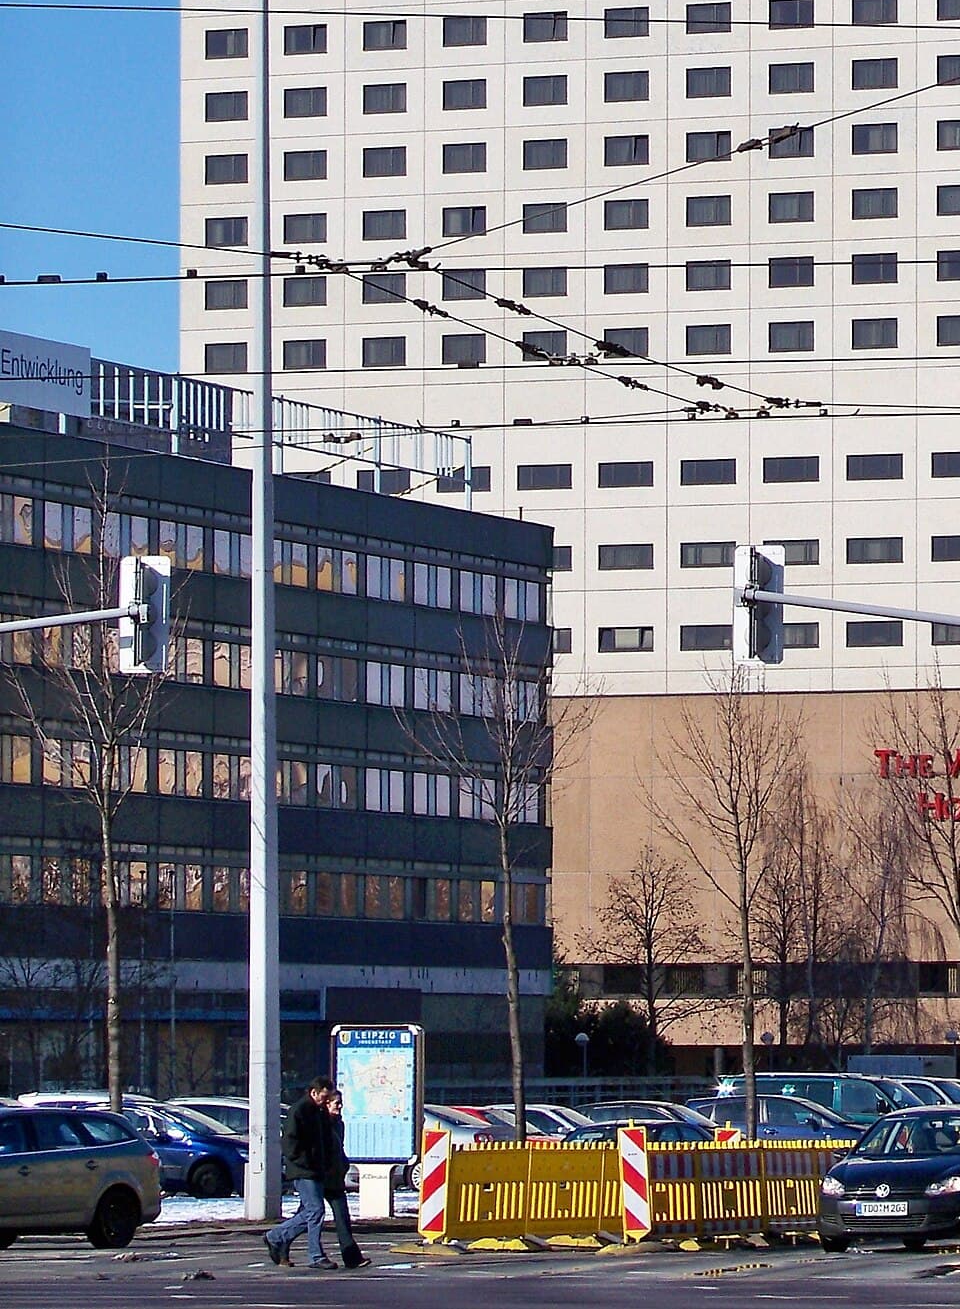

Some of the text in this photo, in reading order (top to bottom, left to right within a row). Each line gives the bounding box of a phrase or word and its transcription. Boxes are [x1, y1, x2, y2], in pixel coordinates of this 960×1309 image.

[1, 348, 84, 396] Entwicklung
[874, 749, 935, 779] THE
[355, 1030, 396, 1040] LEIPZIG
[864, 1204, 878, 1213] TDO
[883, 1204, 890, 1213] M
